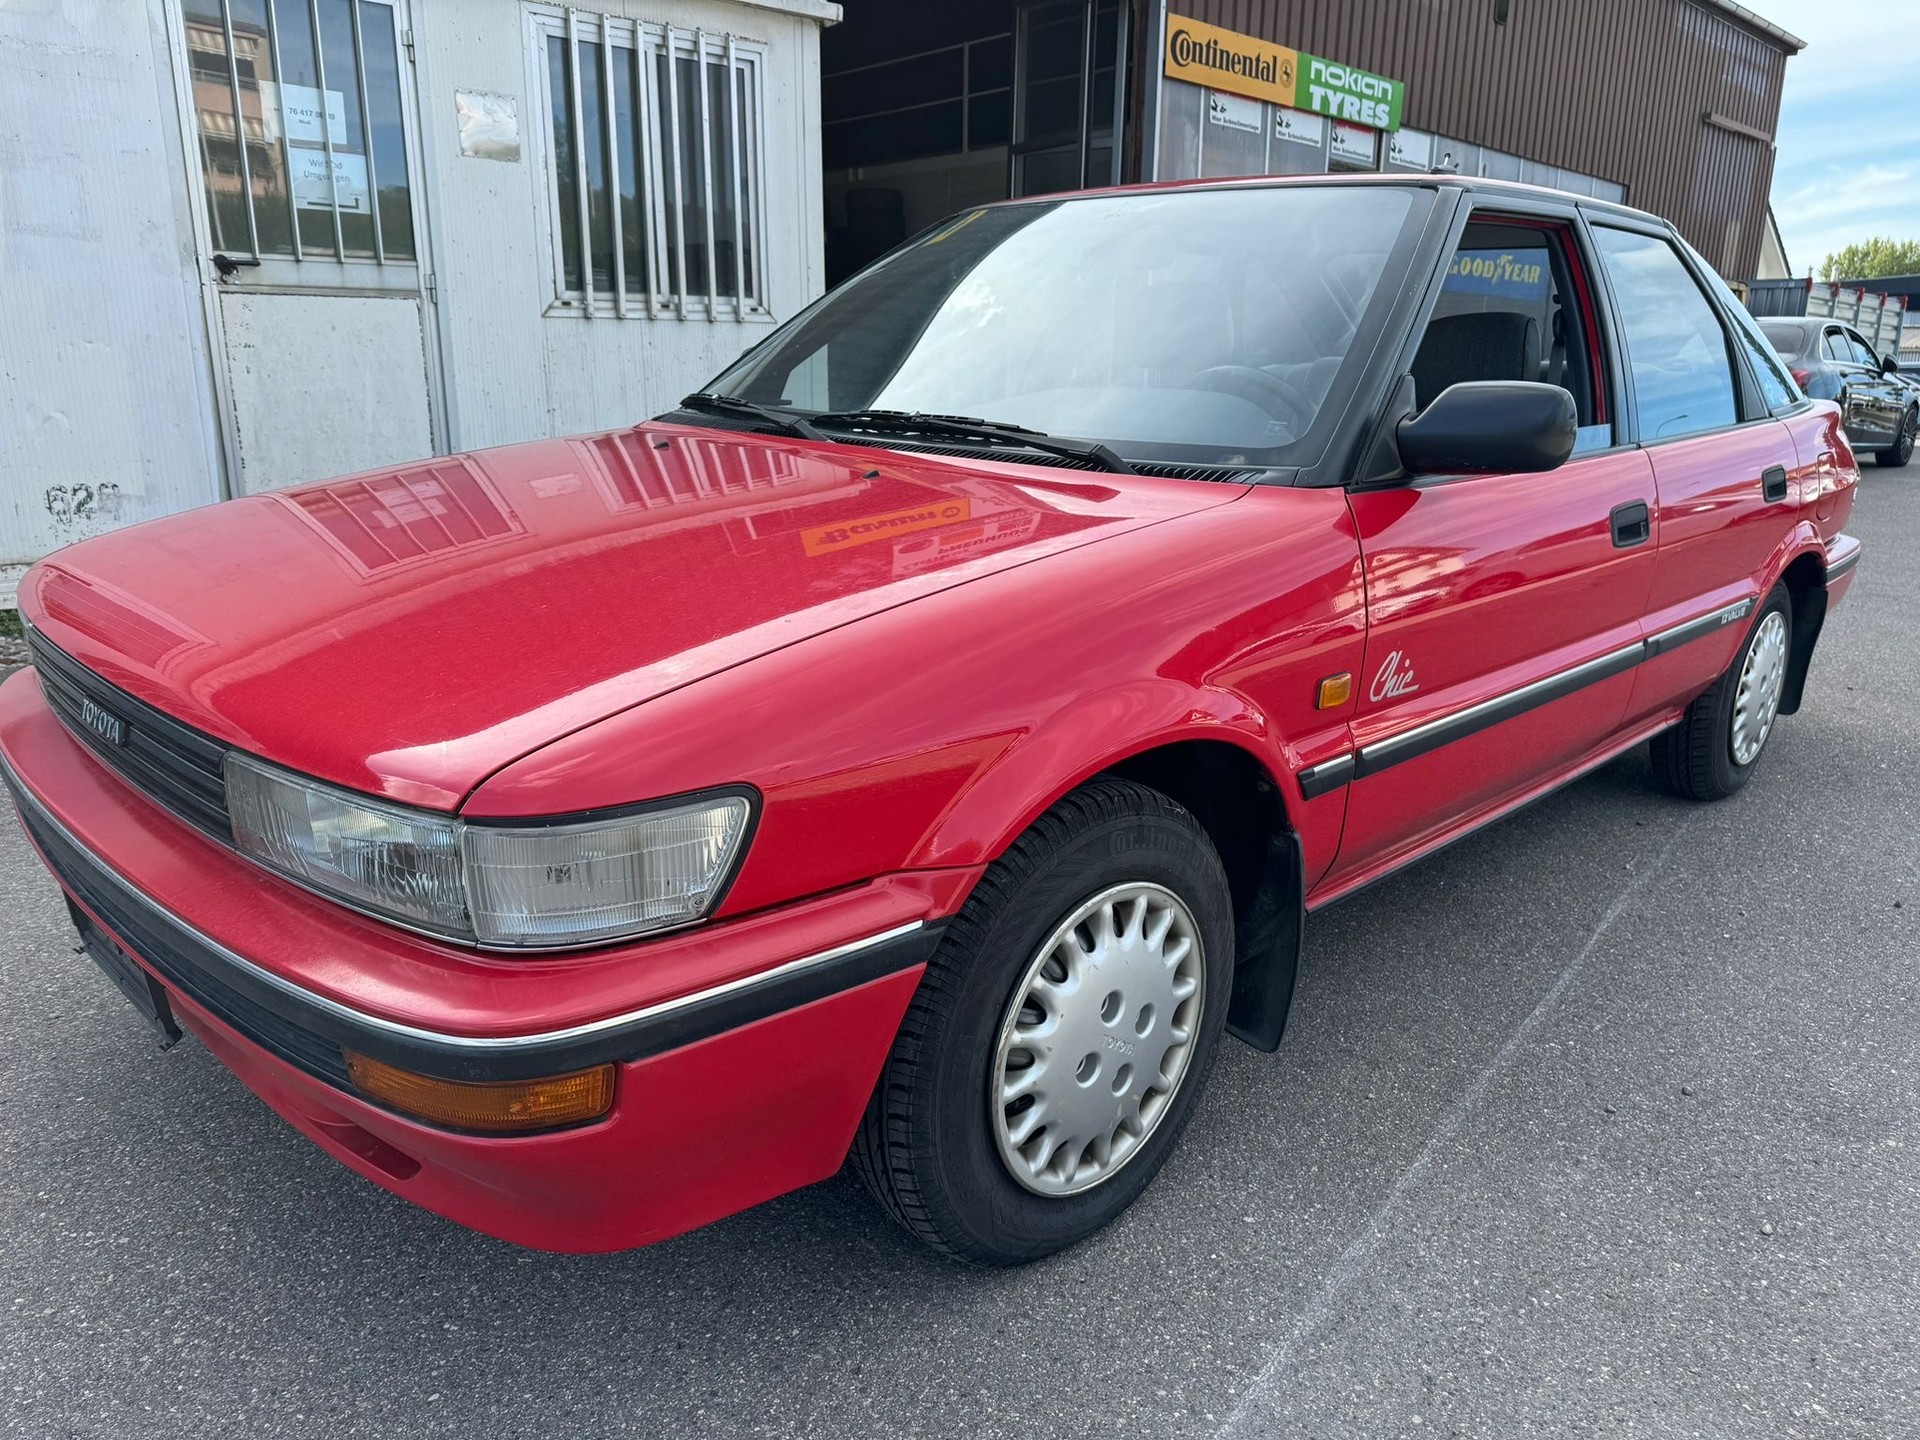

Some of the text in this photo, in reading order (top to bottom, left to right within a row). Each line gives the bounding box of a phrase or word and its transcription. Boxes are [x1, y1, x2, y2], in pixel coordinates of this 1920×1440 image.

[1170, 29, 1278, 84] Continental
[1309, 83, 1390, 128] TYRES
[308, 158, 323, 167] Wir
[1370, 650, 1420, 702] Chic
[82, 698, 119, 744] TOYOTA
[1103, 1033, 1136, 1057] TOYOTA
